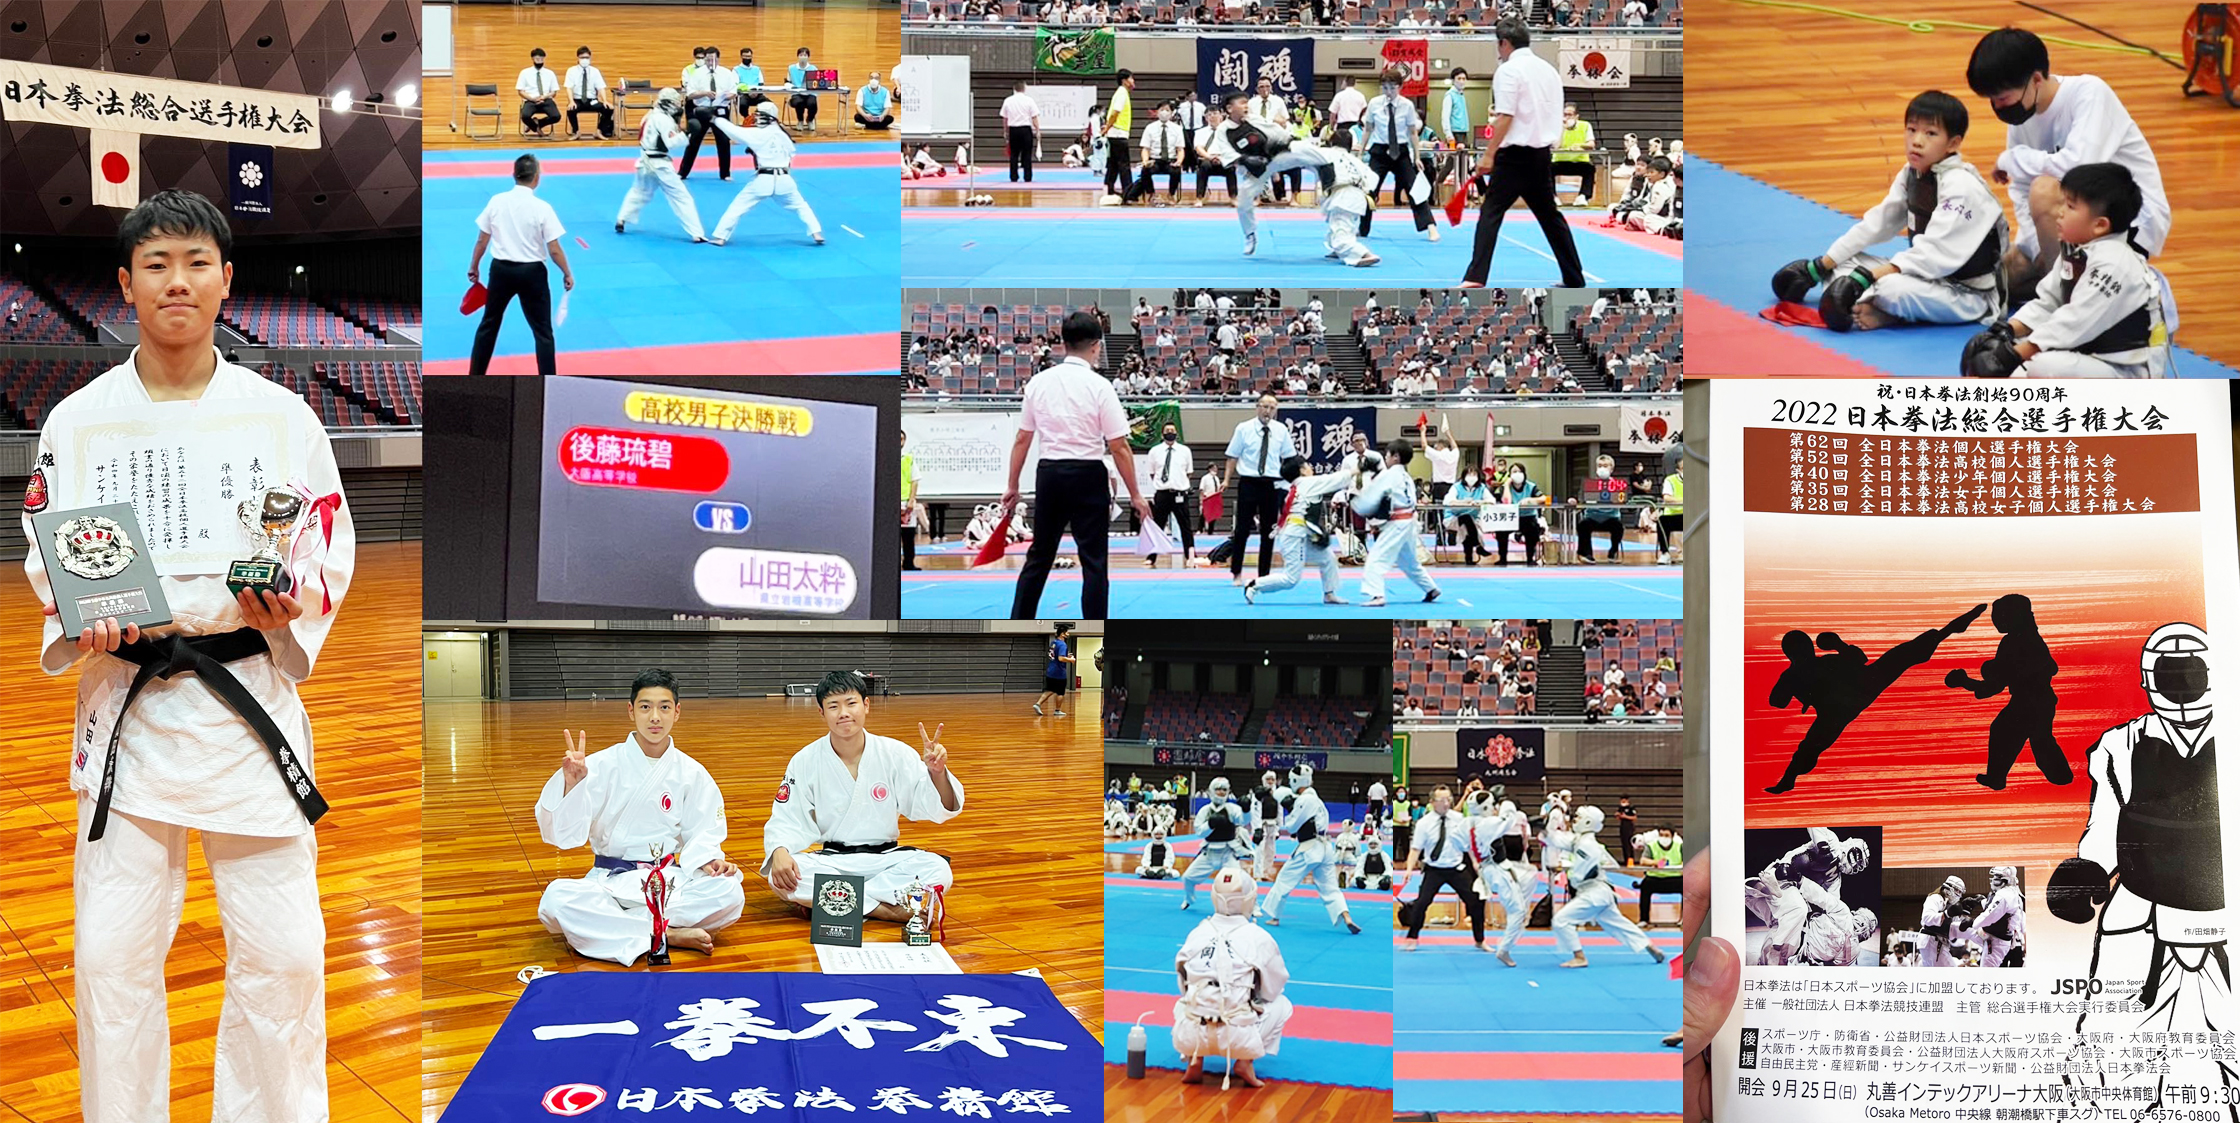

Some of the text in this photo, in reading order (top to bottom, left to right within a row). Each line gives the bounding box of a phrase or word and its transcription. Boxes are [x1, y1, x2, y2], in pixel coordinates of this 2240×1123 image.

[5, 78, 314, 134] 日本拳法総合選手権大会
[1877, 383, 2068, 403] 祝・日本拳法創始90周年
[641, 397, 798, 434] 高校男子決勝戦
[1771, 399, 2170, 433] 2022 日本拳法総合選手権大会
[569, 432, 673, 470] 後藤琉碧
[1790, 432, 2079, 454] 第62回 全日本拳法個人選手権大会
[1790, 448, 2117, 470] 第52回 全日本拳法高校個人選手権大会
[220, 463, 234, 499] 準優勝
[1790, 464, 2117, 484] 第40回 全日本拳法少年個人選手権大会
[1790, 479, 2118, 499] 第35回 全日本拳法女子個人選手権大会
[1790, 495, 2156, 515] 第28回 全日本拳法高校女子個人選手権大会
[711, 507, 735, 533] VS
[1483, 512, 1517, 522] 小3男子
[740, 557, 846, 594] 山田太粋
[279, 745, 311, 800] 拳精館
[1744, 979, 2037, 995] 日本拳法は「日本スポーツ協会」に加盟しております。
[2050, 978, 2103, 995] JSPO
[1743, 998, 2143, 1014] 主催 一般社団法人 日本拳法競技連盟 主管 総合選手権大会実行委員会
[1741, 1031, 1756, 1067] 後援
[1738, 1077, 1765, 1097] 開会
[1772, 1079, 1857, 1101] 9月25日(日)
[1864, 1106, 2221, 1122] (Osaka Metoro 中央線 朝潮橋駅下車スグ) TEL 06-6576-0800
